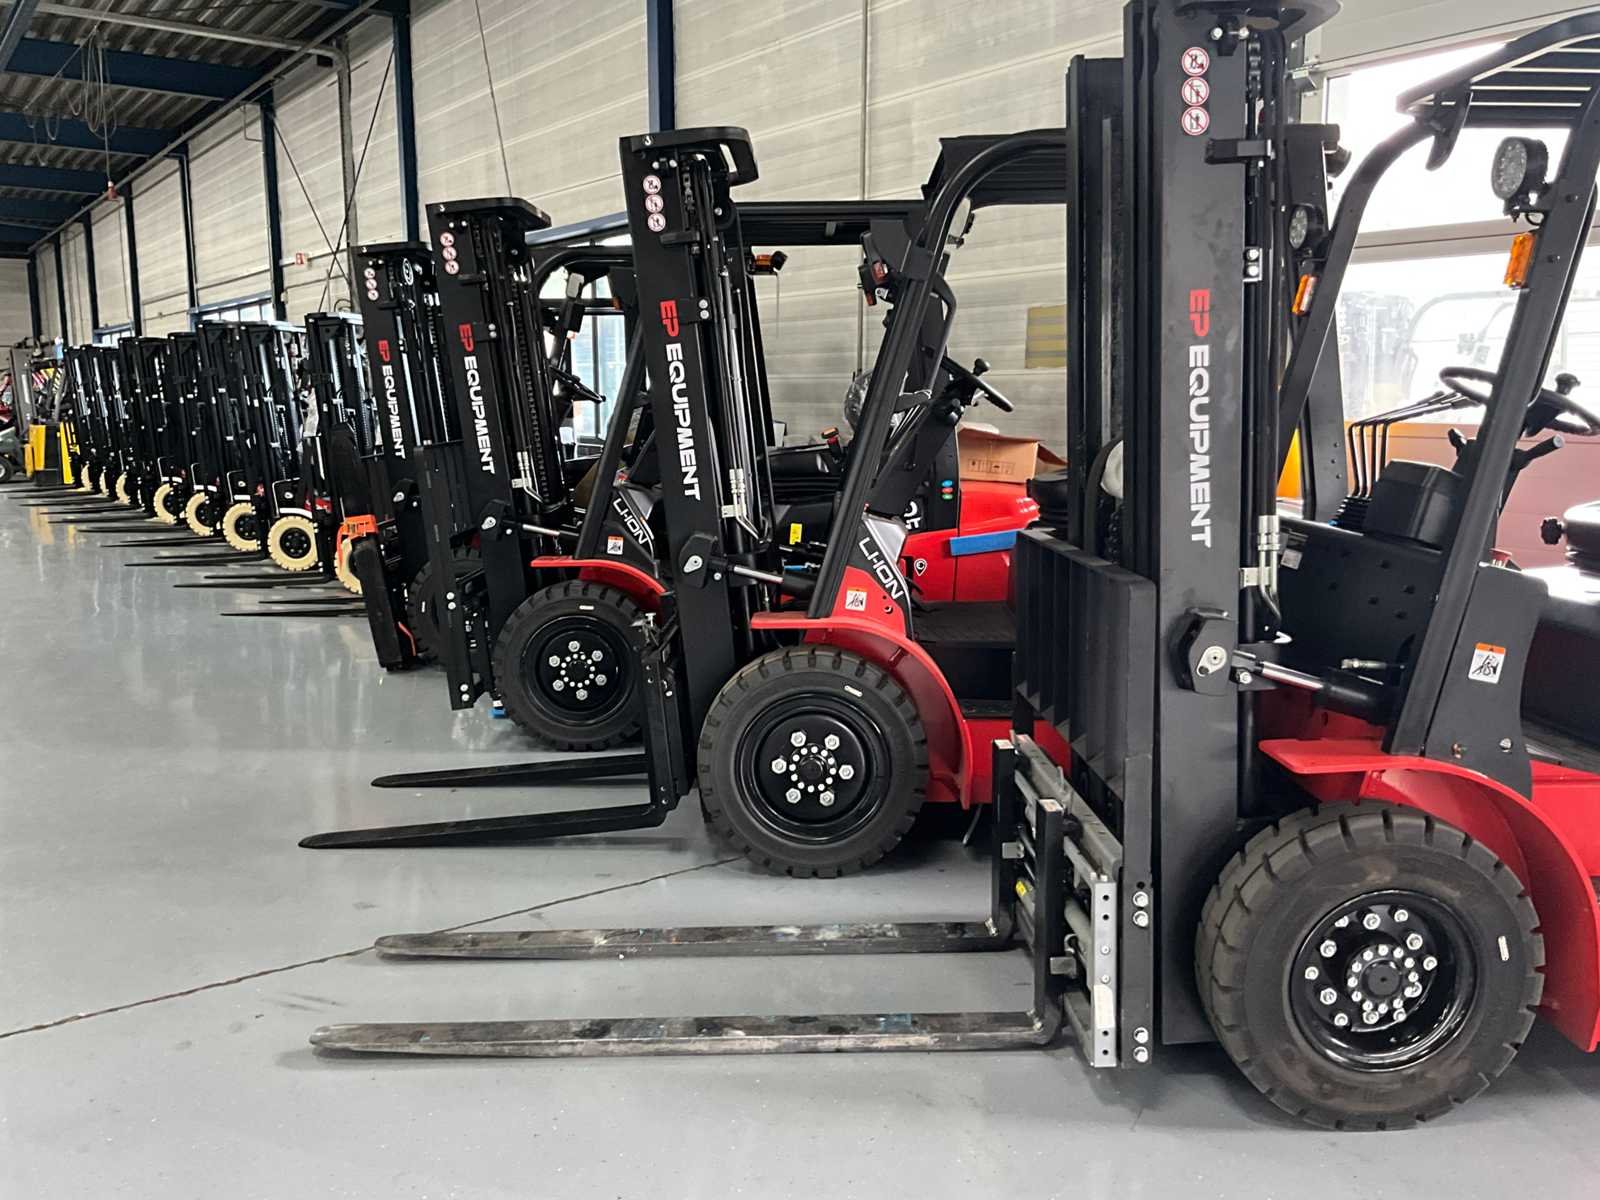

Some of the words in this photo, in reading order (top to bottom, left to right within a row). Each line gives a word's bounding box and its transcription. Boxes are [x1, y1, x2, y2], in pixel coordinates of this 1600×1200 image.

[458, 324, 475, 352] EP
[659, 300, 681, 337] EP
[1189, 288, 1210, 337] EP
[378, 339, 391, 362] EP
[382, 364, 406, 459] EQUIPMENT
[463, 355, 496, 475] EQUIPMENT
[665, 343, 701, 500] EQUIPMENT
[1189, 344, 1212, 548] EQUIPMENT
